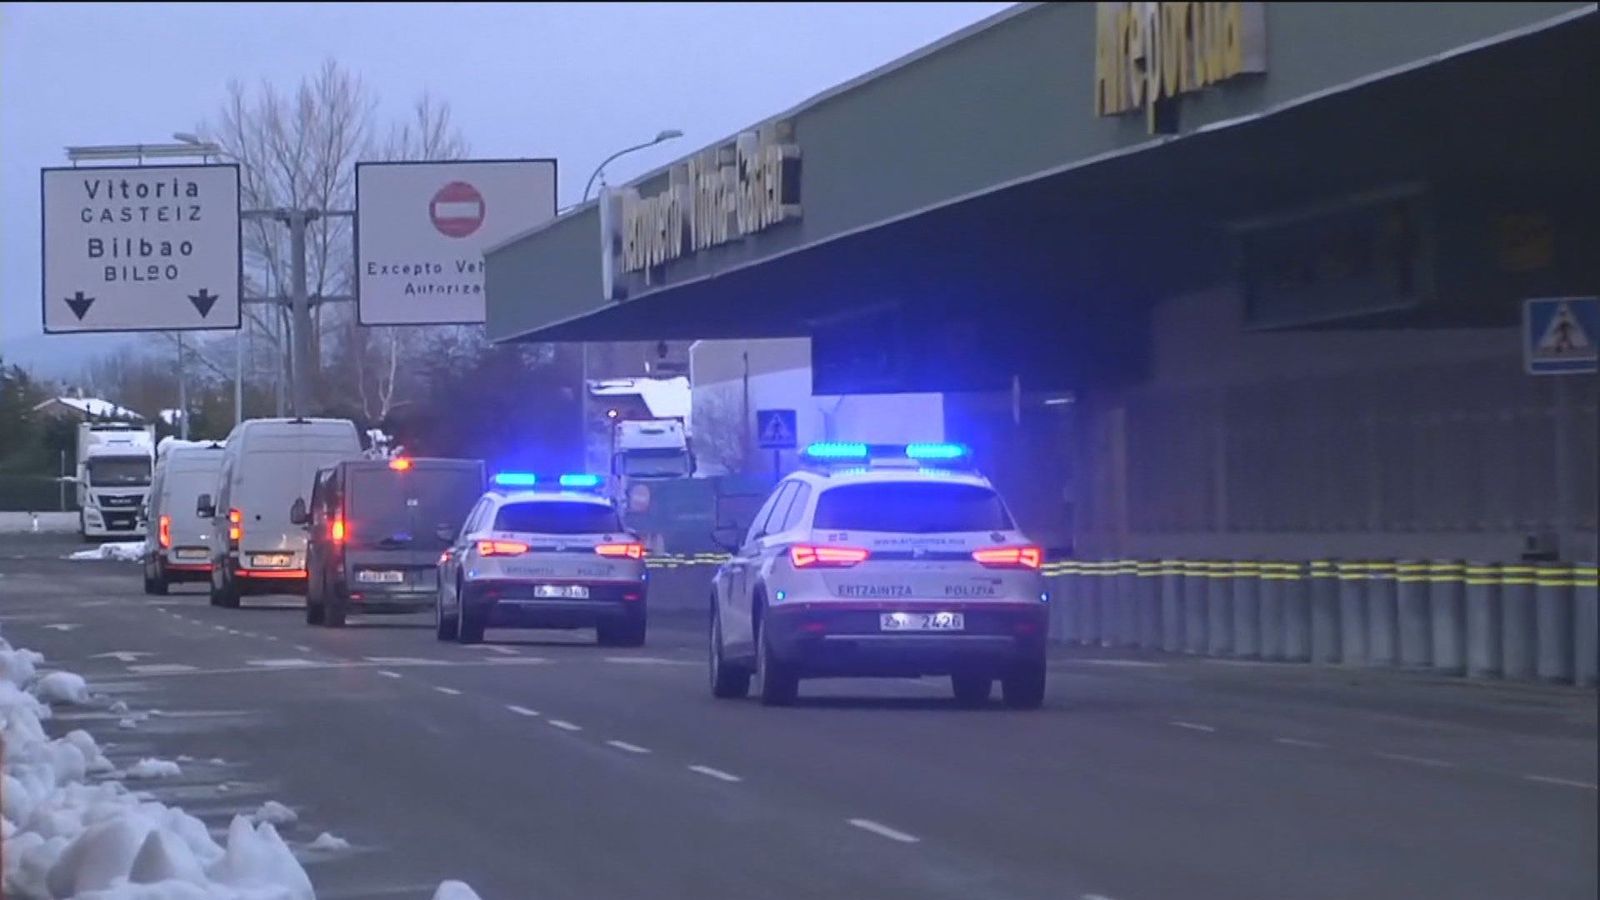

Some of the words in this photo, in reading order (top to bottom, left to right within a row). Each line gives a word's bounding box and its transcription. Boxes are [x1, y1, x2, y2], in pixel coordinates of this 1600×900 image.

[84, 178, 198, 199] Vitoria
[81, 205, 201, 223] GASTEIZ
[88, 237, 193, 258] Bilbao
[367, 261, 442, 276] Excepto
[837, 584, 913, 596] ERTZAINTZA
[944, 584, 995, 596] POLIZIA
